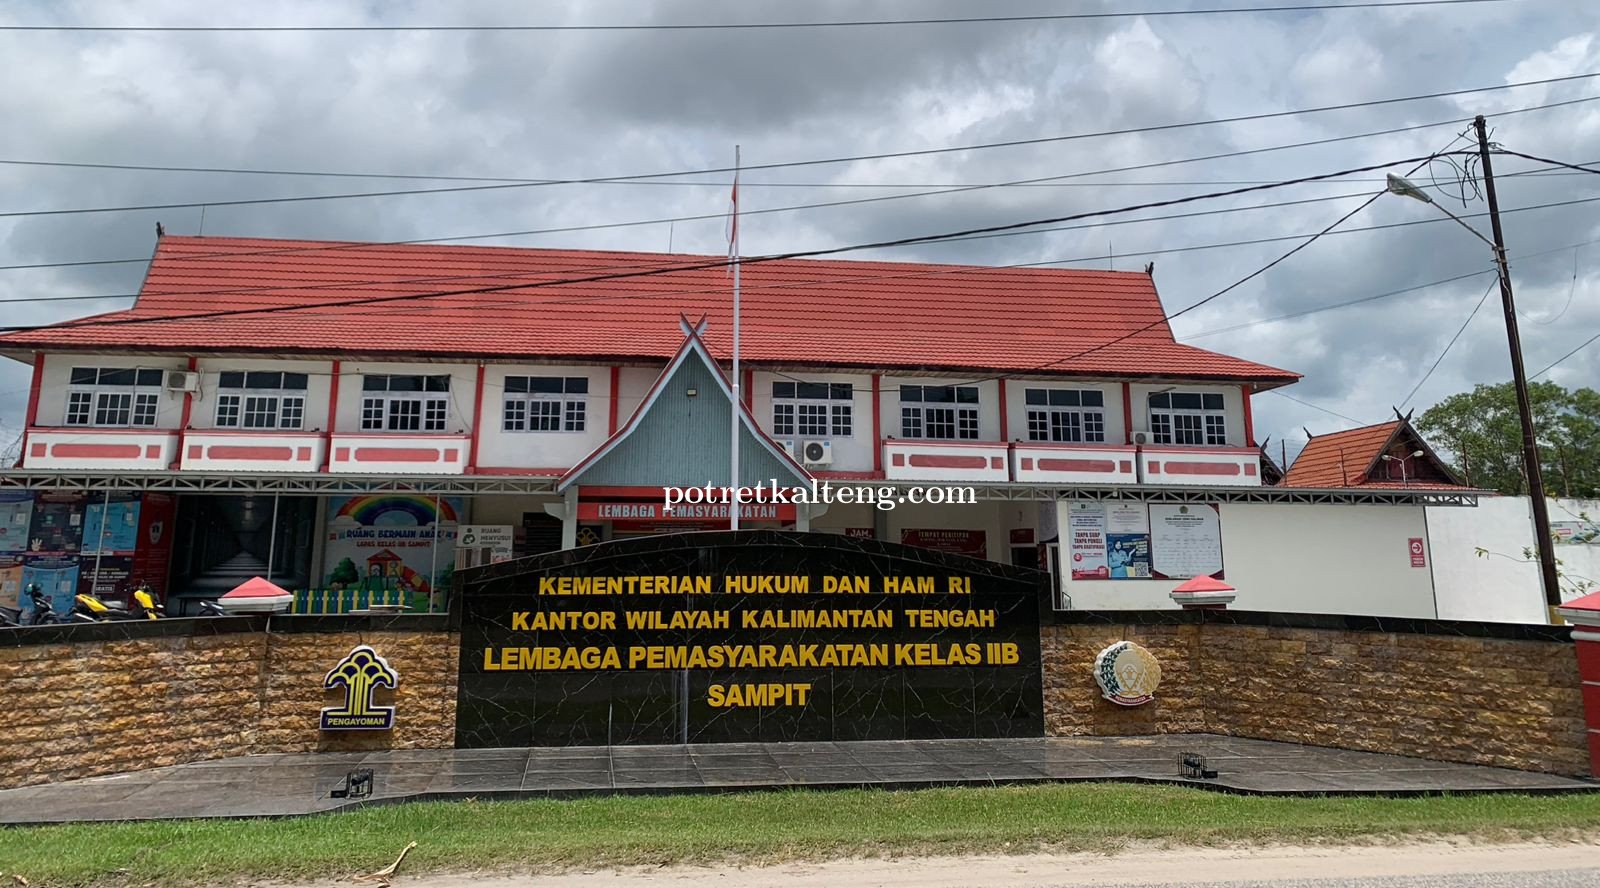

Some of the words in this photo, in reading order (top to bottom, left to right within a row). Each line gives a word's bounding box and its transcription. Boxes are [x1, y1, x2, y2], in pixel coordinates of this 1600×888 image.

[598, 505, 655, 518] LEMBAGA
[540, 576, 711, 594] KEMENTERIAN
[726, 576, 808, 593] HUKUM
[824, 576, 869, 593] DAN
[884, 577, 934, 593] HAM
[949, 577, 970, 592] RI
[513, 612, 615, 630] KANTOR
[626, 611, 729, 629] WILAYAH
[743, 610, 892, 628] KALIMANTAN
[905, 610, 994, 627] TENGAH
[484, 647, 621, 670] LEMBAGA
[629, 644, 888, 668] PEMASYARAKATAN
[895, 644, 981, 665] KELAS
[987, 643, 1019, 664] IIB
[709, 684, 810, 706] SAMPIT
[328, 717, 385, 725] PENGAYOMAN
